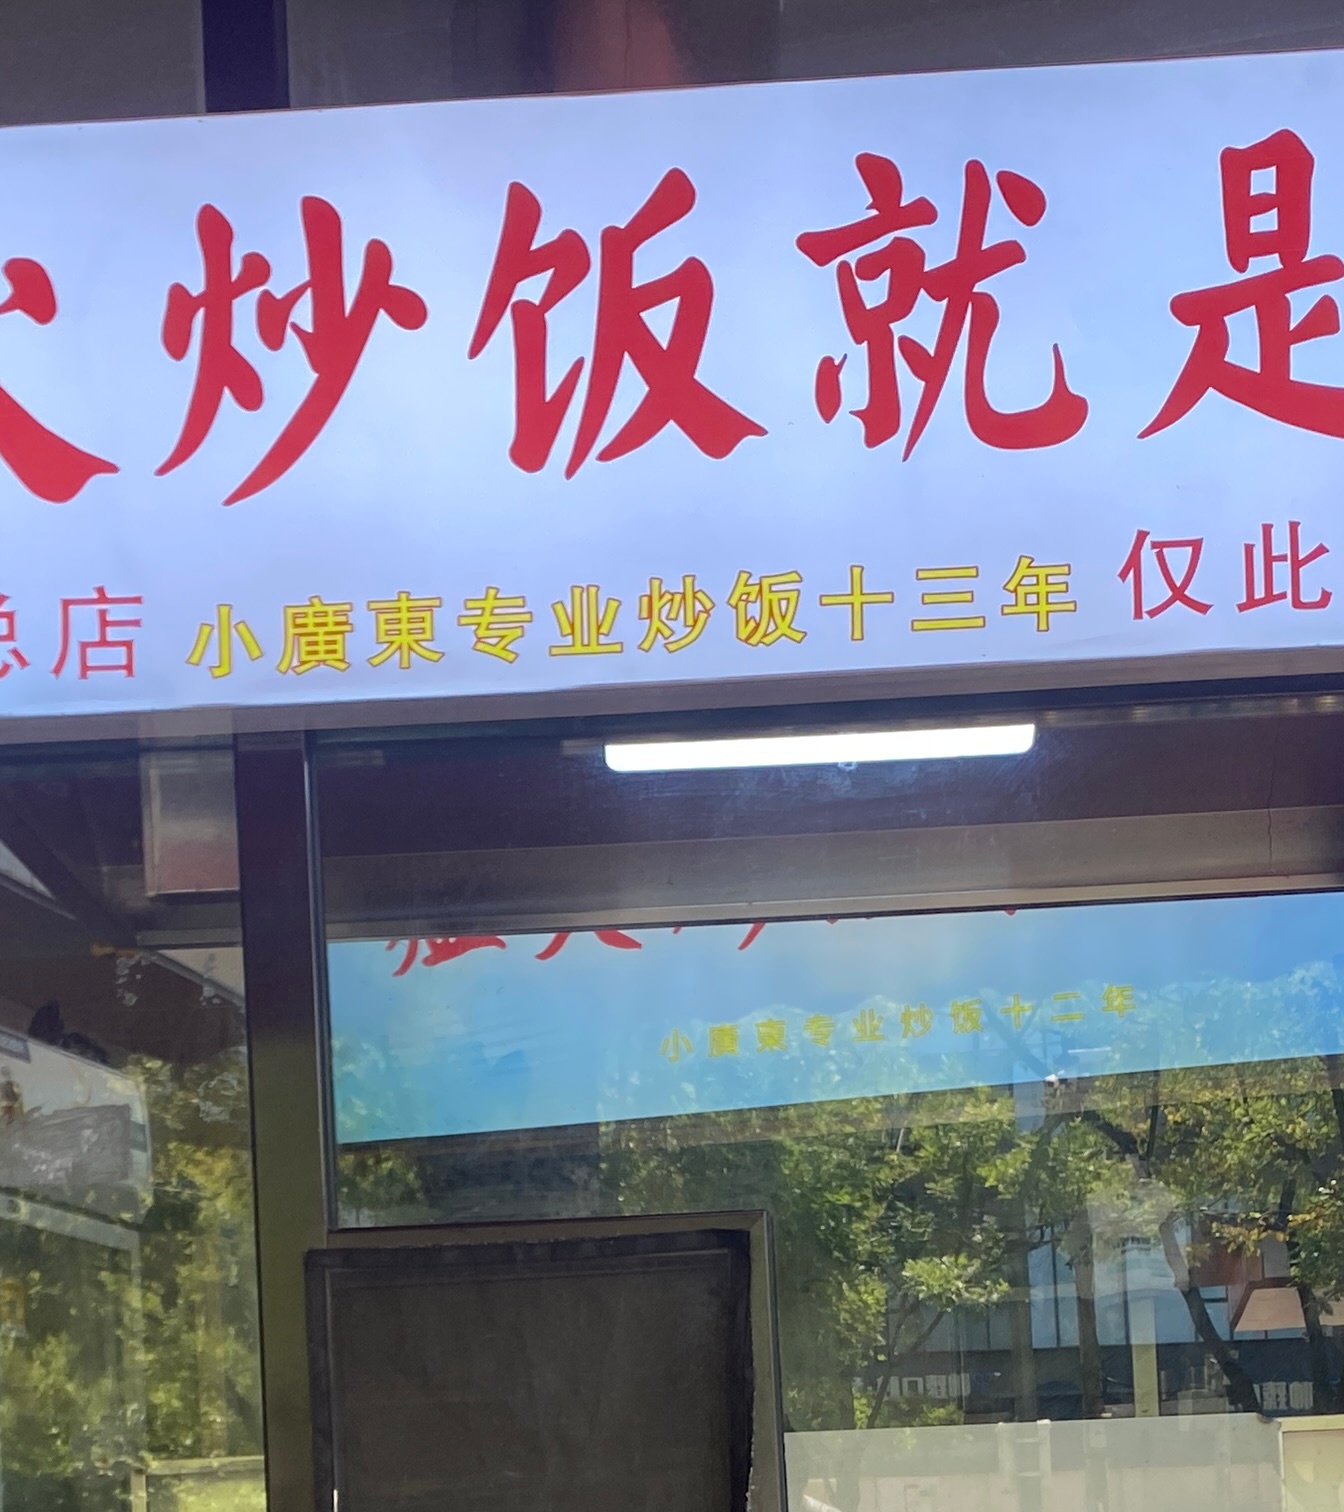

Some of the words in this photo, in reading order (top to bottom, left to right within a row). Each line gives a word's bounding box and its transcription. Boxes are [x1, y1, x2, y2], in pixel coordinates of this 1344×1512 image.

[186, 553, 1078, 678] 小廣東专业炒饭十三年
